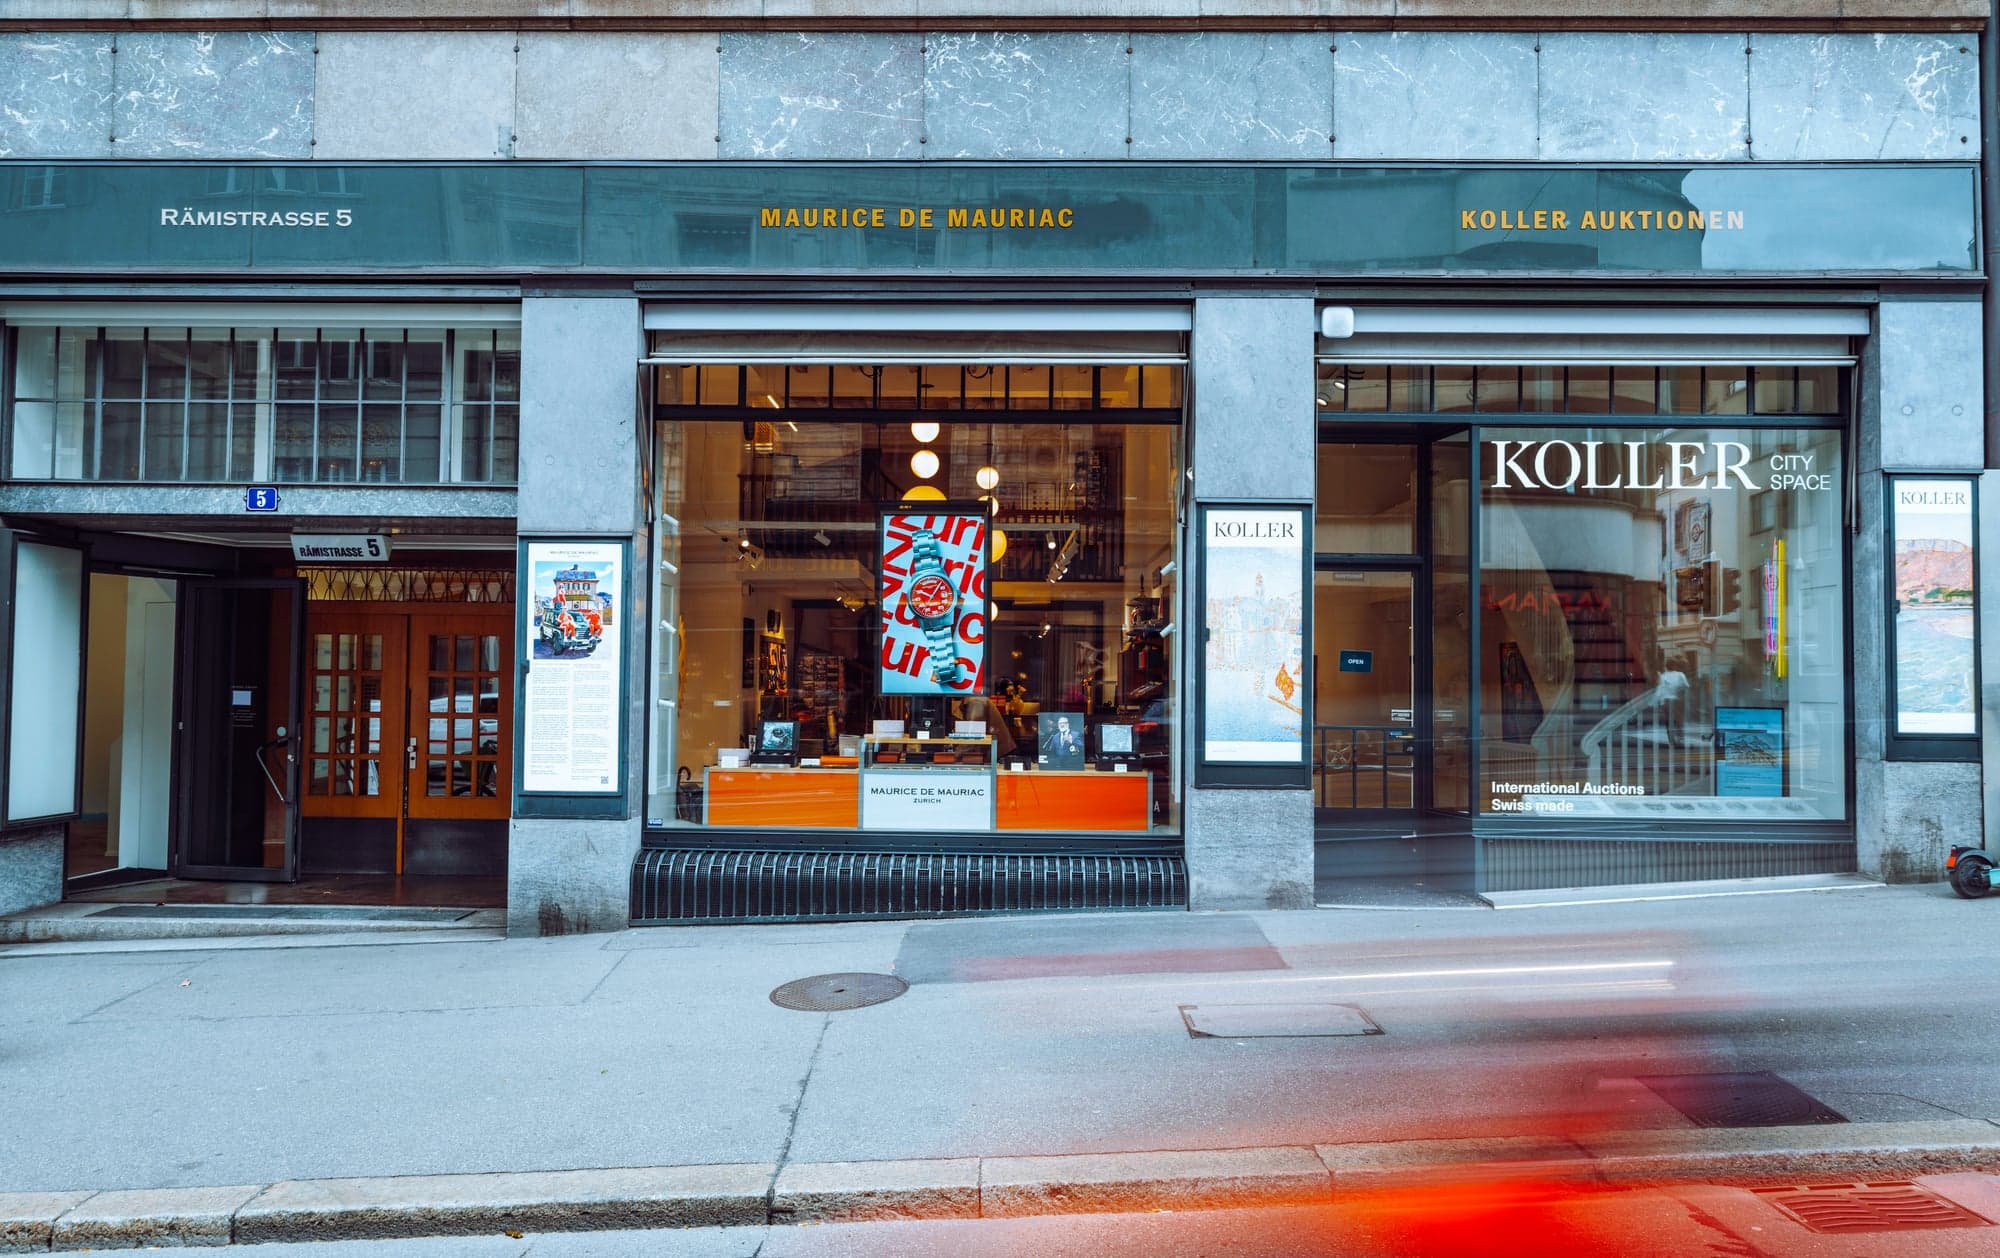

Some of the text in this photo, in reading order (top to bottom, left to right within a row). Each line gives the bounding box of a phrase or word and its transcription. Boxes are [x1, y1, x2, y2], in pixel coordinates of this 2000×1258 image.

[336, 208, 353, 227] 5
[760, 207, 1074, 229] MAURICE DE MAURIAC
[1461, 209, 1745, 231] KOLLER AUKTIONEN
[1491, 439, 1762, 491] KOLLER
[1770, 455, 1814, 471] CITY
[1770, 474, 1832, 491] SPACE
[256, 490, 267, 508] 5
[1902, 490, 1966, 506] KOLLER
[1214, 521, 1295, 539] KOLLER
[299, 538, 381, 558] RÄMISTRASSE 5
[1347, 658, 1365, 666] OPEN
[870, 787, 985, 797] MAURICE DE MAURIAC
[1491, 781, 1645, 796] International Auctions
[1491, 799, 1574, 812] Swiss made
